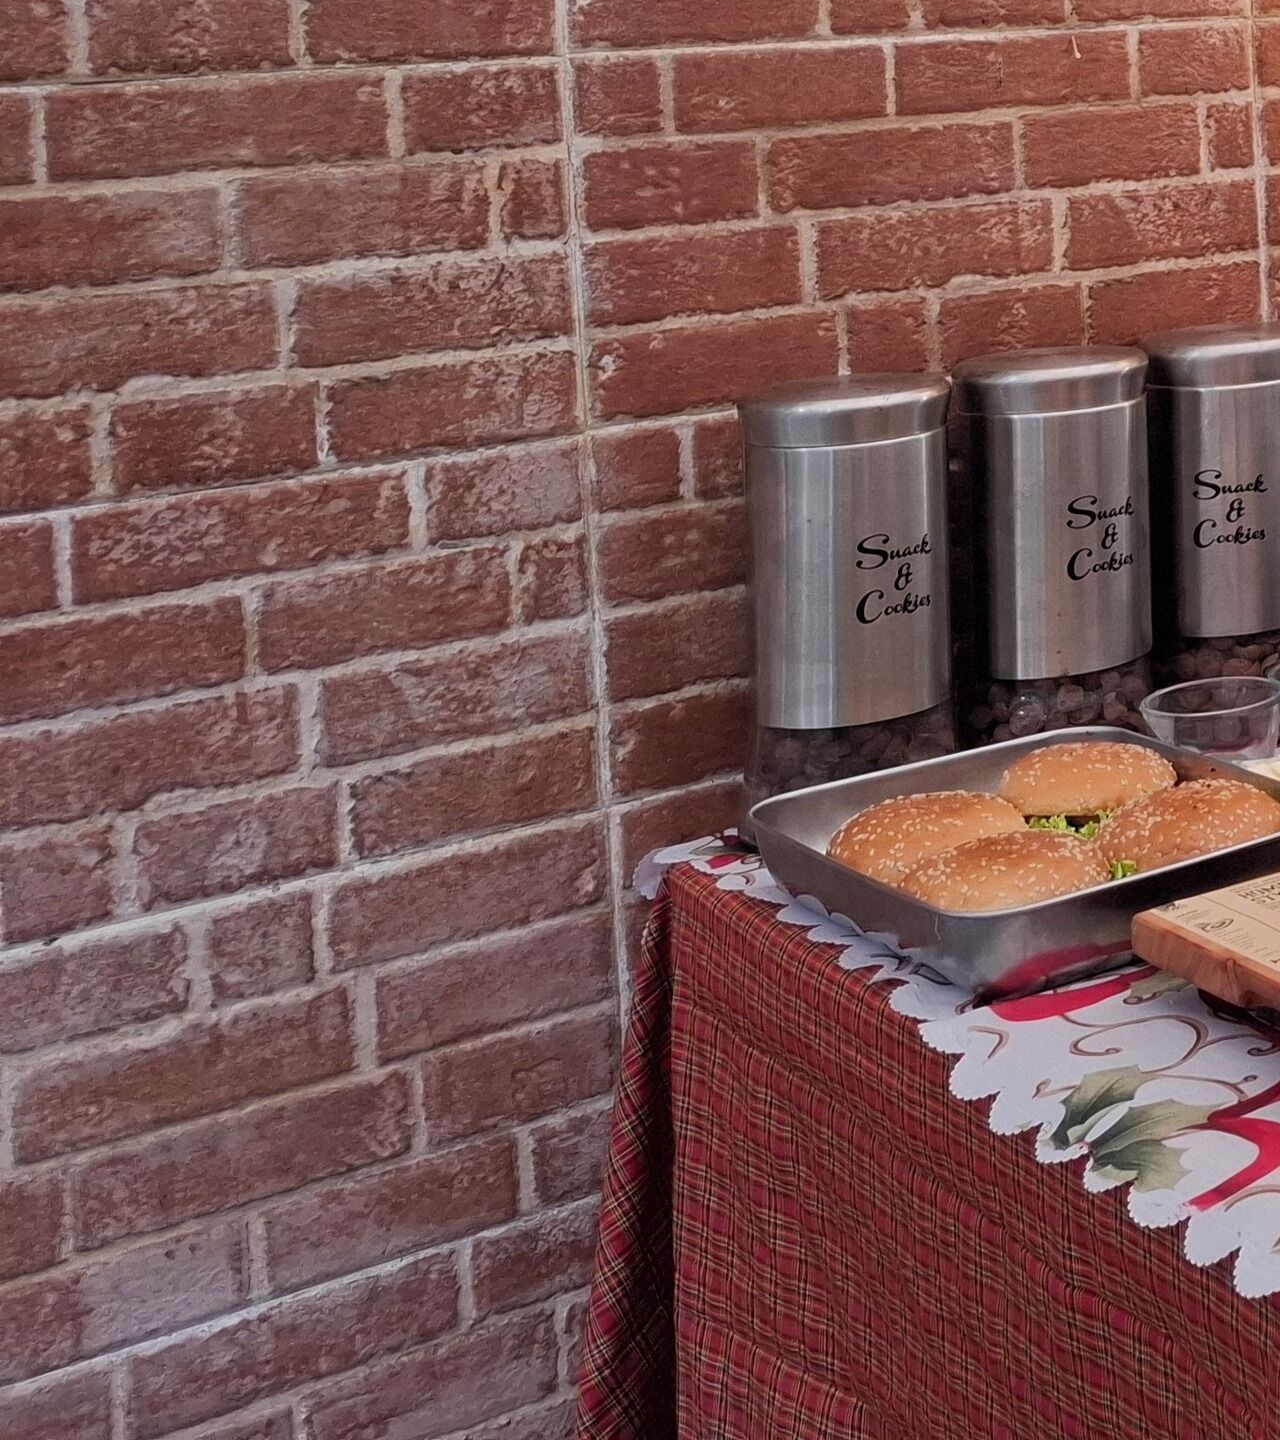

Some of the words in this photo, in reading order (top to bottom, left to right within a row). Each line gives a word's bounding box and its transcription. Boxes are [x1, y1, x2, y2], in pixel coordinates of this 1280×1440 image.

[1192, 469, 1269, 500] Snack
[1066, 495, 1135, 529] Snack
[1225, 498, 1245, 523] &
[1101, 523, 1118, 550] &
[1193, 519, 1266, 548] Cookies
[856, 533, 932, 570] Snack
[1066, 547, 1134, 581] Cookies
[894, 562, 913, 591] &
[856, 589, 931, 625] Cookies
